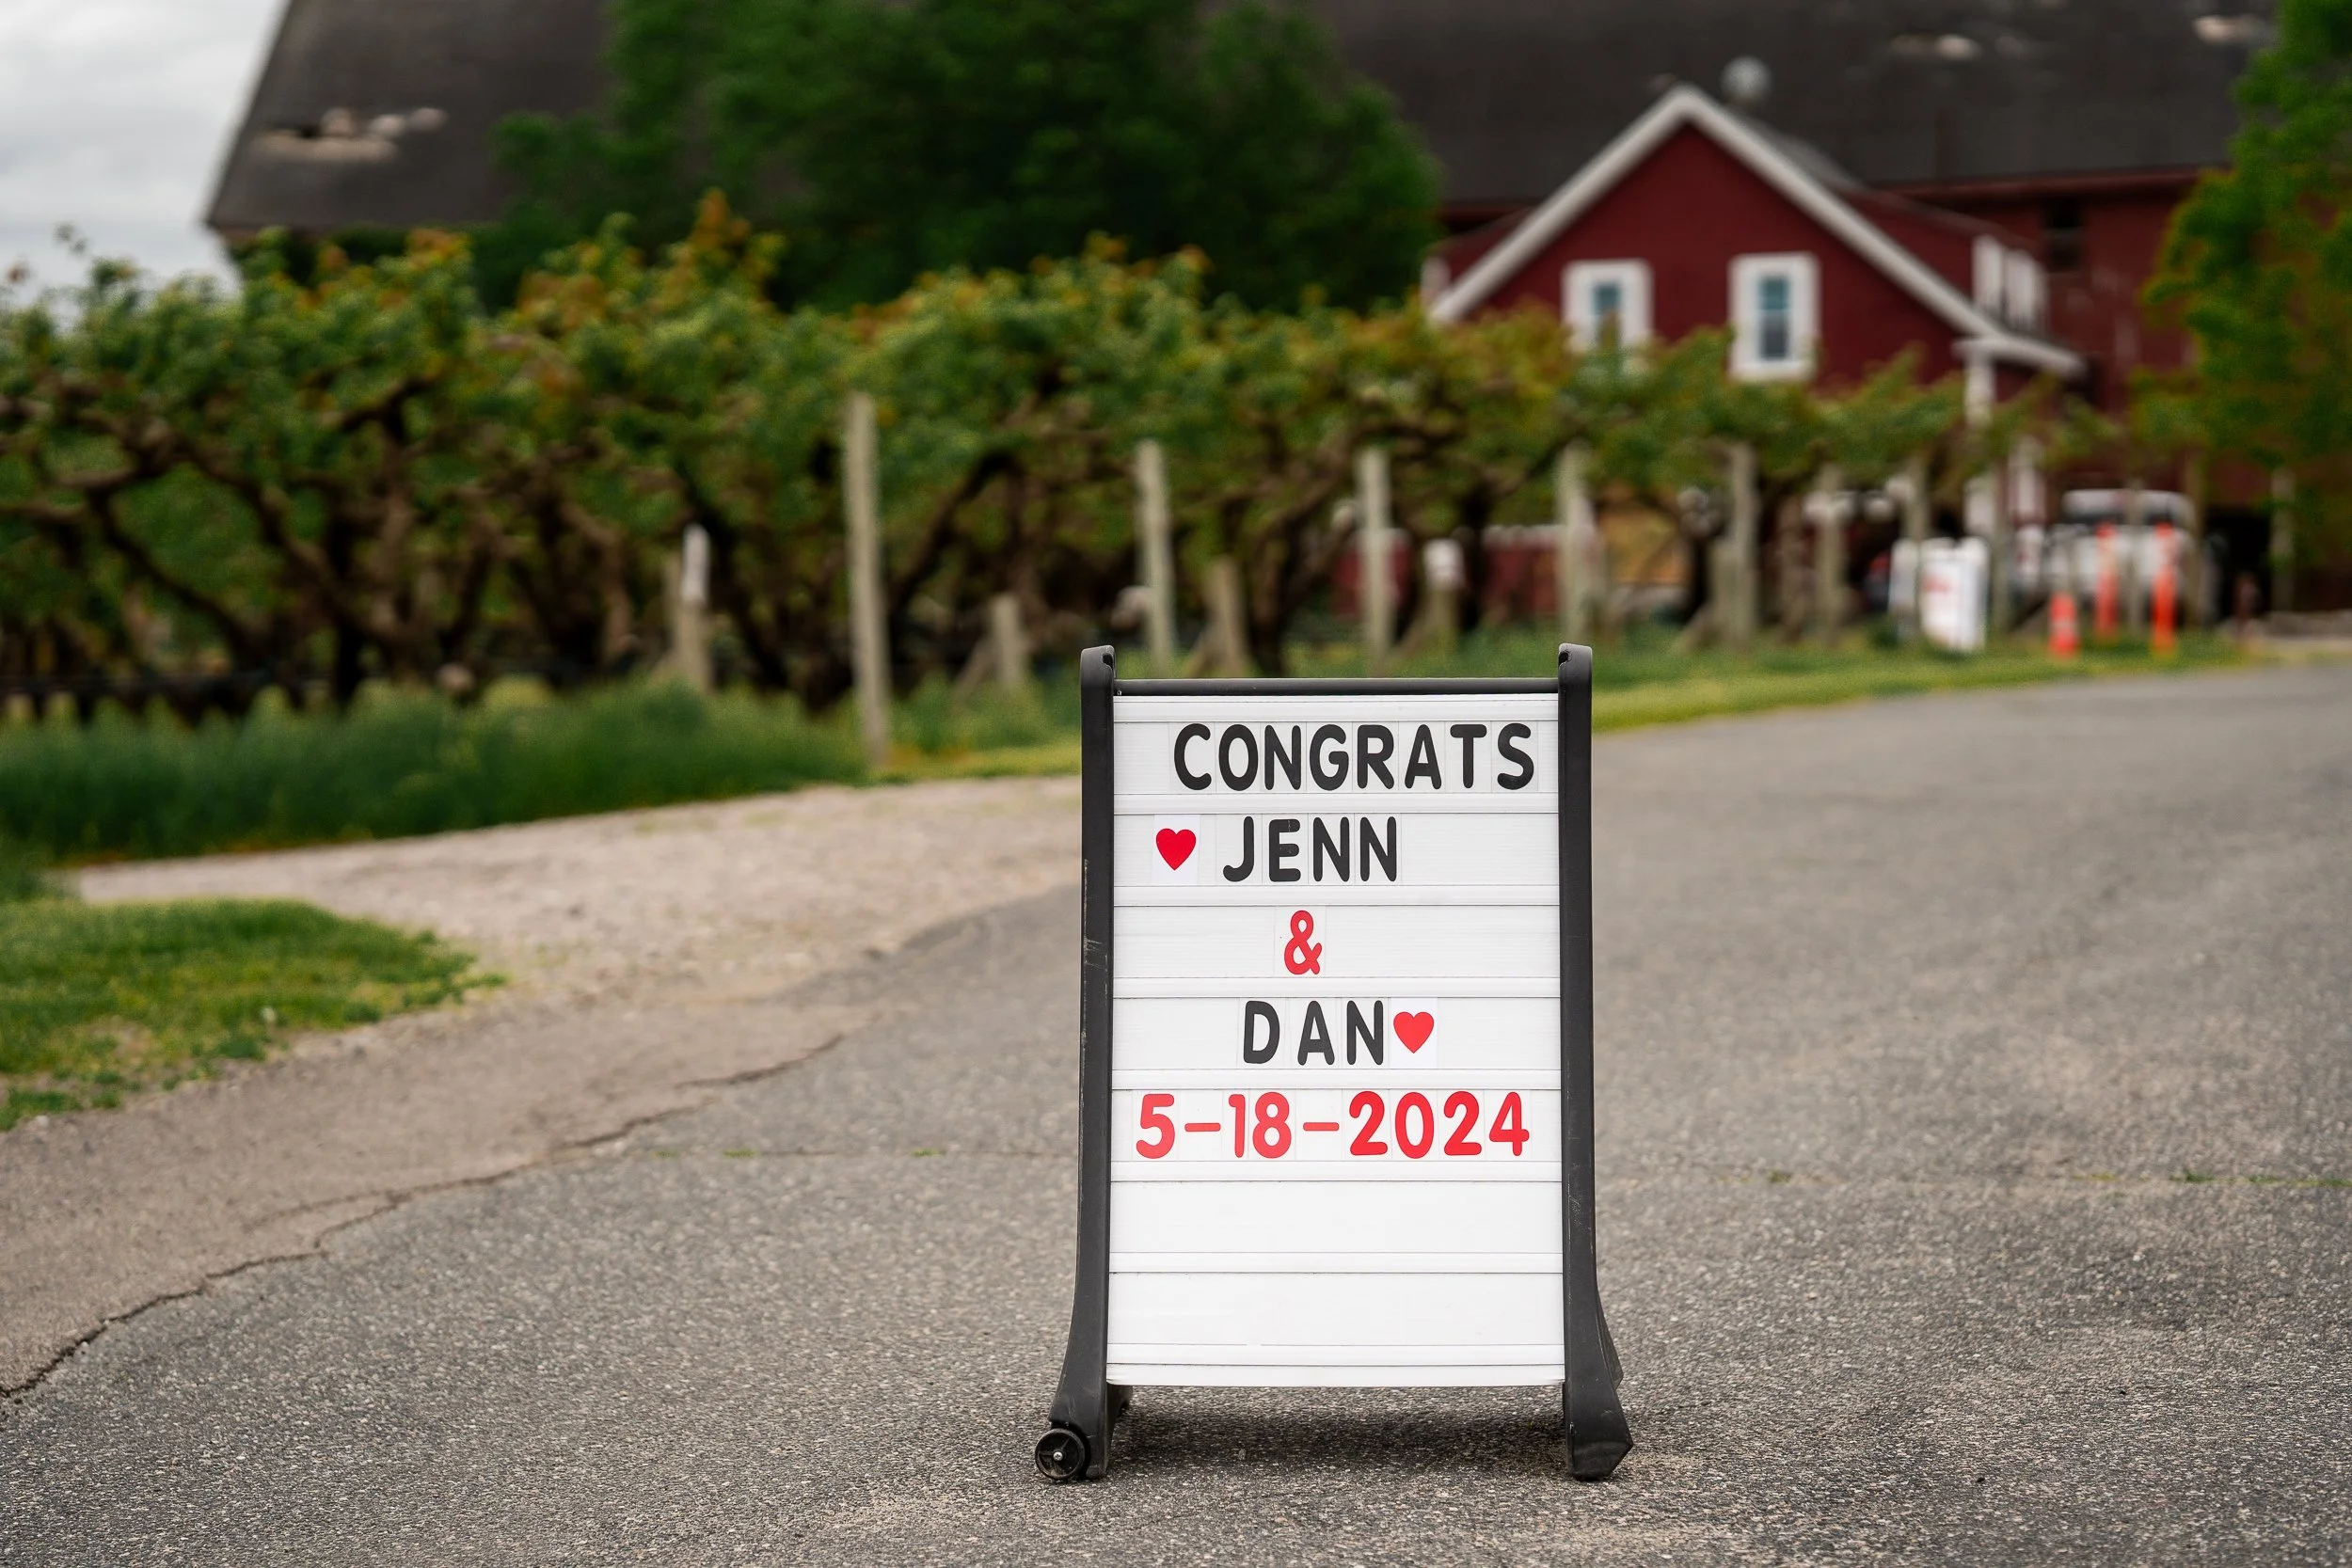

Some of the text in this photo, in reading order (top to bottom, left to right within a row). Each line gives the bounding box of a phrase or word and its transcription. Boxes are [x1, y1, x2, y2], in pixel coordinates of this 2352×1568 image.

[1173, 722, 1535, 792] CONGRATS
[1222, 816, 1397, 882] JENN
[1283, 910, 1323, 975] &
[1243, 1000, 1384, 1066] DAN
[1136, 1090, 1531, 1160] 5-18-2024
